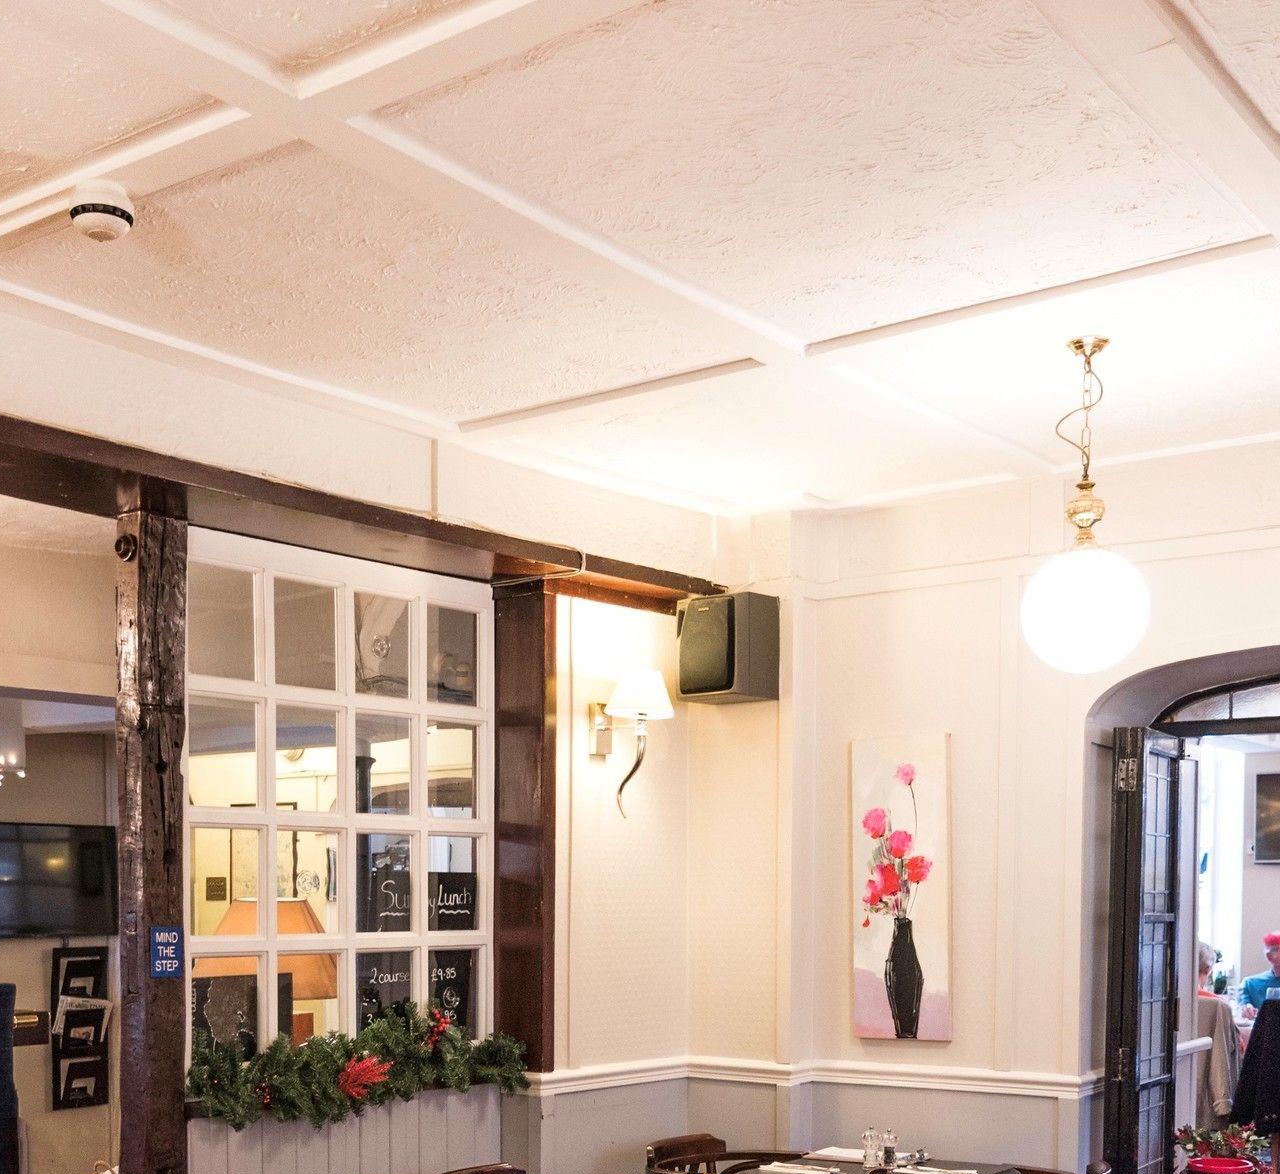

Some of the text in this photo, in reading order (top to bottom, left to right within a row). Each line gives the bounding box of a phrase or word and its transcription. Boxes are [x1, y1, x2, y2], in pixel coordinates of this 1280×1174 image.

[437, 884, 472, 907] Lunch
[155, 931, 179, 943] MIND
[157, 946, 176, 957] THE
[155, 960, 179, 972] STEP
[431, 967, 457, 982] £9.85
